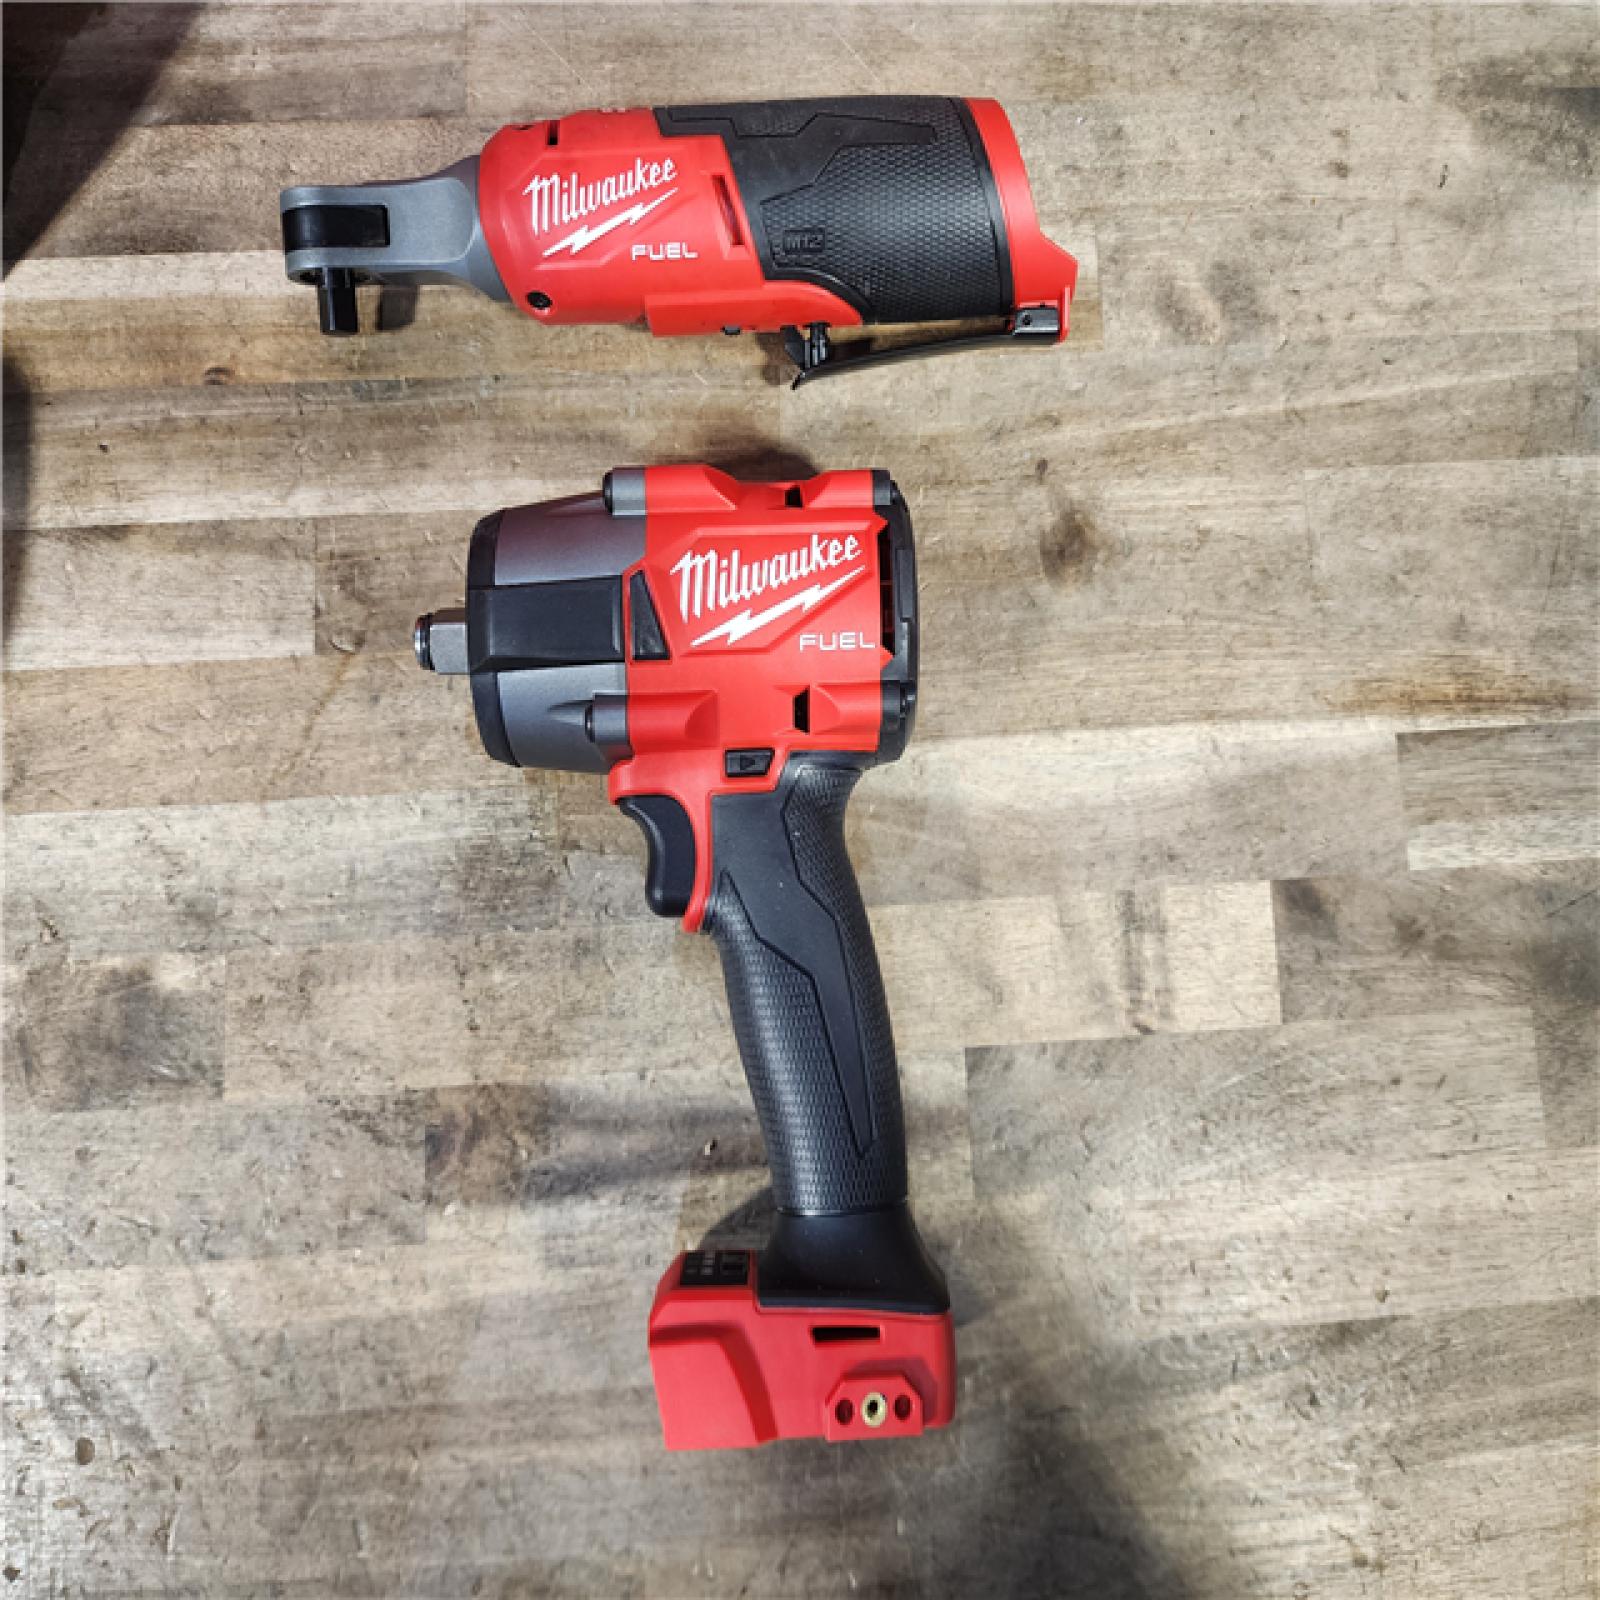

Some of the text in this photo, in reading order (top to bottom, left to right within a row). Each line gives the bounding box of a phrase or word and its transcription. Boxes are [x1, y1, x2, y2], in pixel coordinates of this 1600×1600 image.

[523, 157, 677, 235] Milwaukee
[631, 242, 698, 261] FUEL
[670, 534, 862, 623] Milwaukee
[799, 632, 876, 651] FUEL
